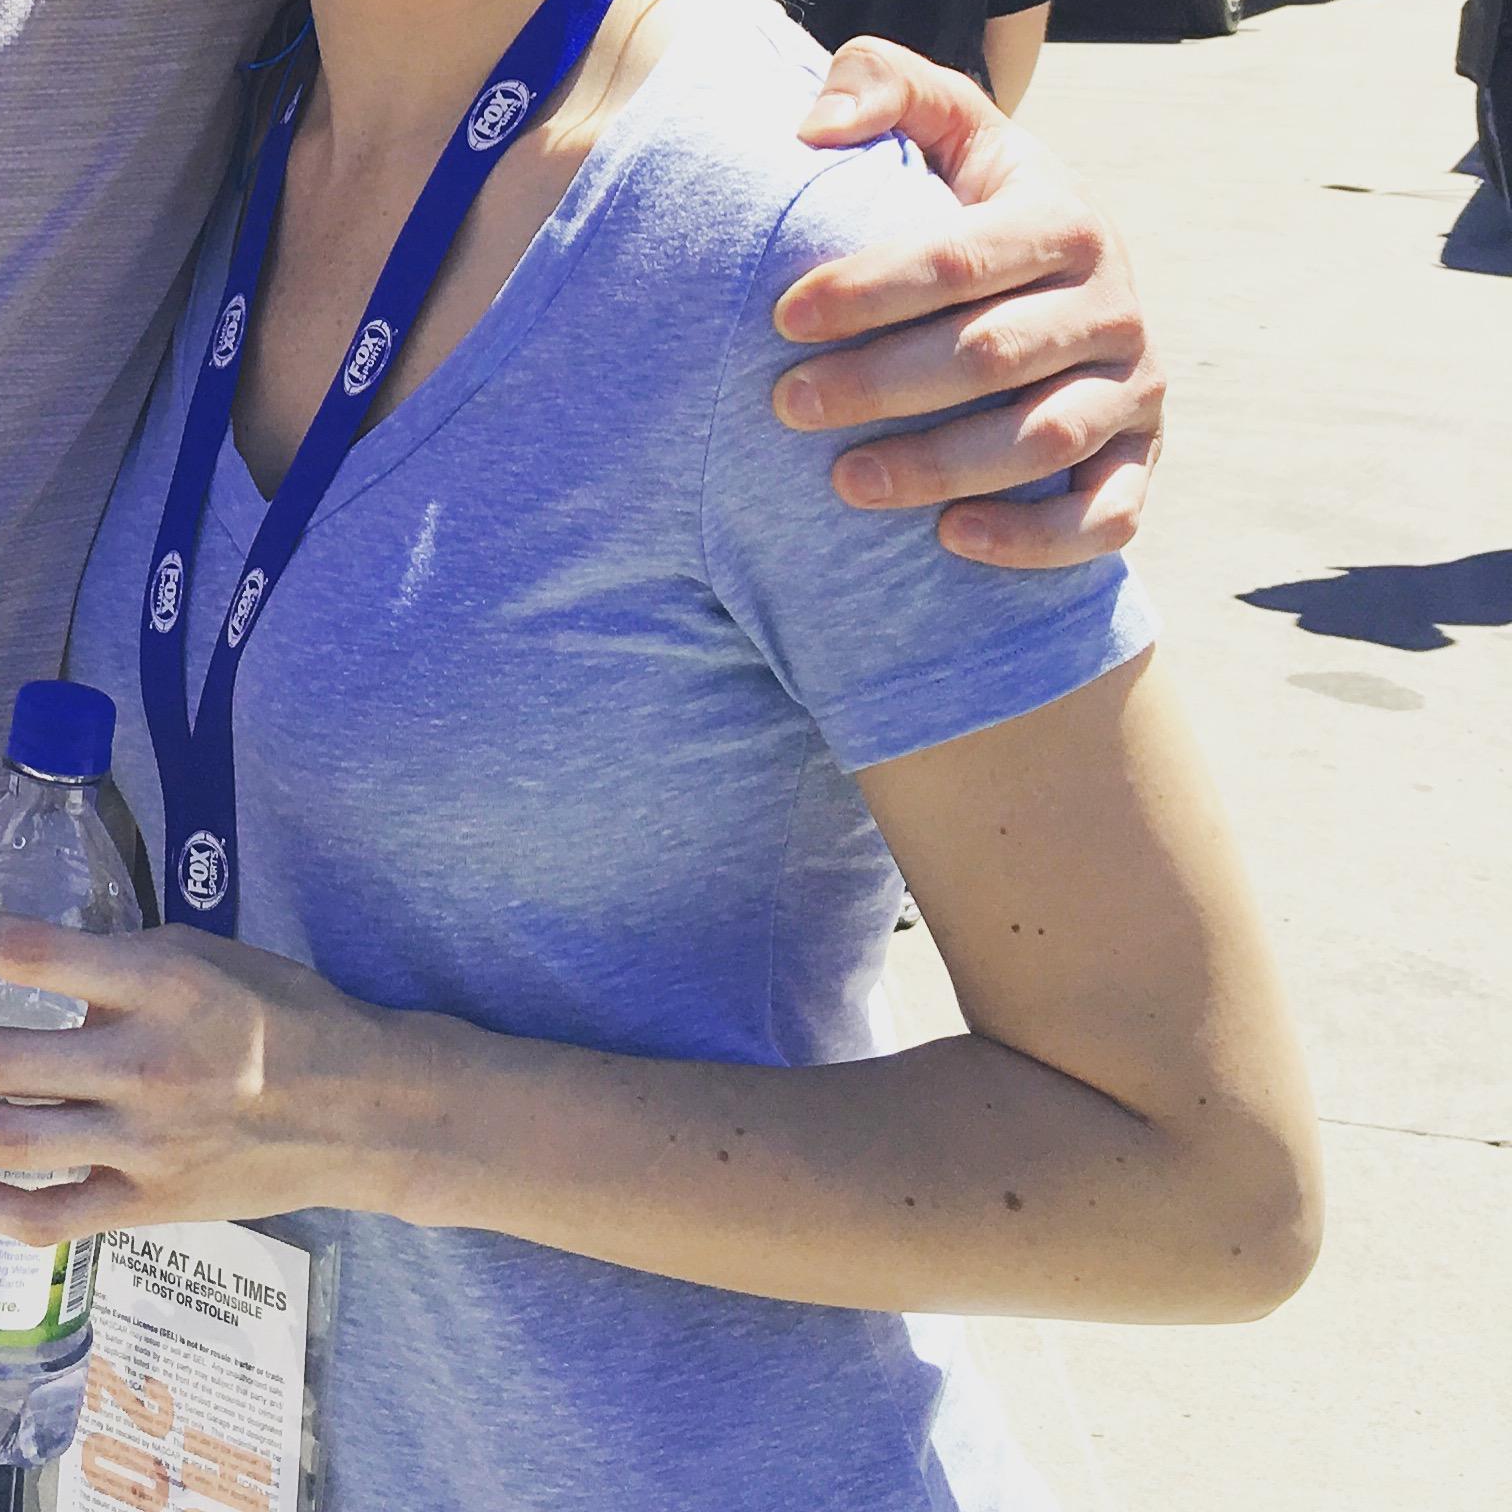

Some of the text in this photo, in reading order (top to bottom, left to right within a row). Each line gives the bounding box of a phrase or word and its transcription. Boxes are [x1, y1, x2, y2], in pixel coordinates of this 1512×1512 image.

[473, 88, 515, 136] FOX
[489, 99, 523, 138] SPORTS
[221, 309, 241, 352] FOX
[347, 330, 381, 380] FOX
[358, 336, 386, 384] SPORTS
[160, 568, 180, 614] FOX
[187, 846, 211, 895] FOX
[208, 849, 219, 895] SPORTS
[111, 1252, 263, 1319] NASCAR NOT RESPONSIBLE
[132, 1274, 239, 1326] IF LOST OR STOLEN
[166, 1249, 190, 1274] AT
[193, 1259, 227, 1289] ALL
[232, 1273, 287, 1311] TIMES
